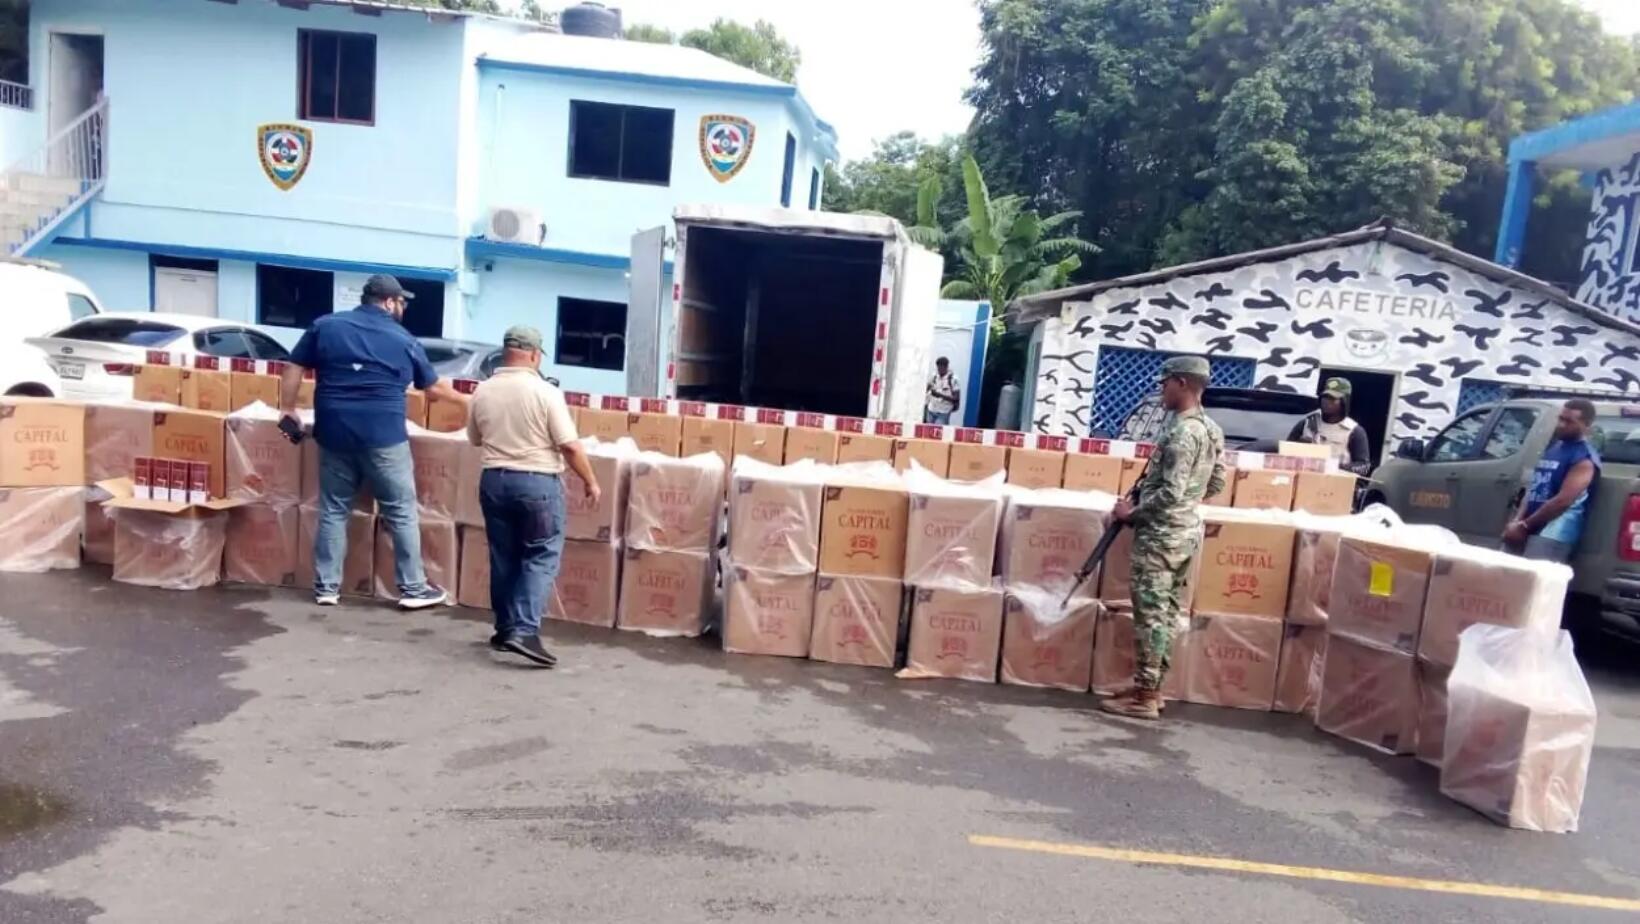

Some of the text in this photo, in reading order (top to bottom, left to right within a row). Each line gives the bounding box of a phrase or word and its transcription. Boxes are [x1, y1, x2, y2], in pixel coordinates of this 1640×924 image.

[1296, 289, 1457, 320] CAFETERIA
[14, 429, 69, 443] CAPITAL
[838, 514, 892, 530] CAPITAL
[1029, 533, 1083, 551] CAPITAL
[1216, 551, 1275, 570] CAPITAL
[929, 615, 982, 632] CAPITAL
